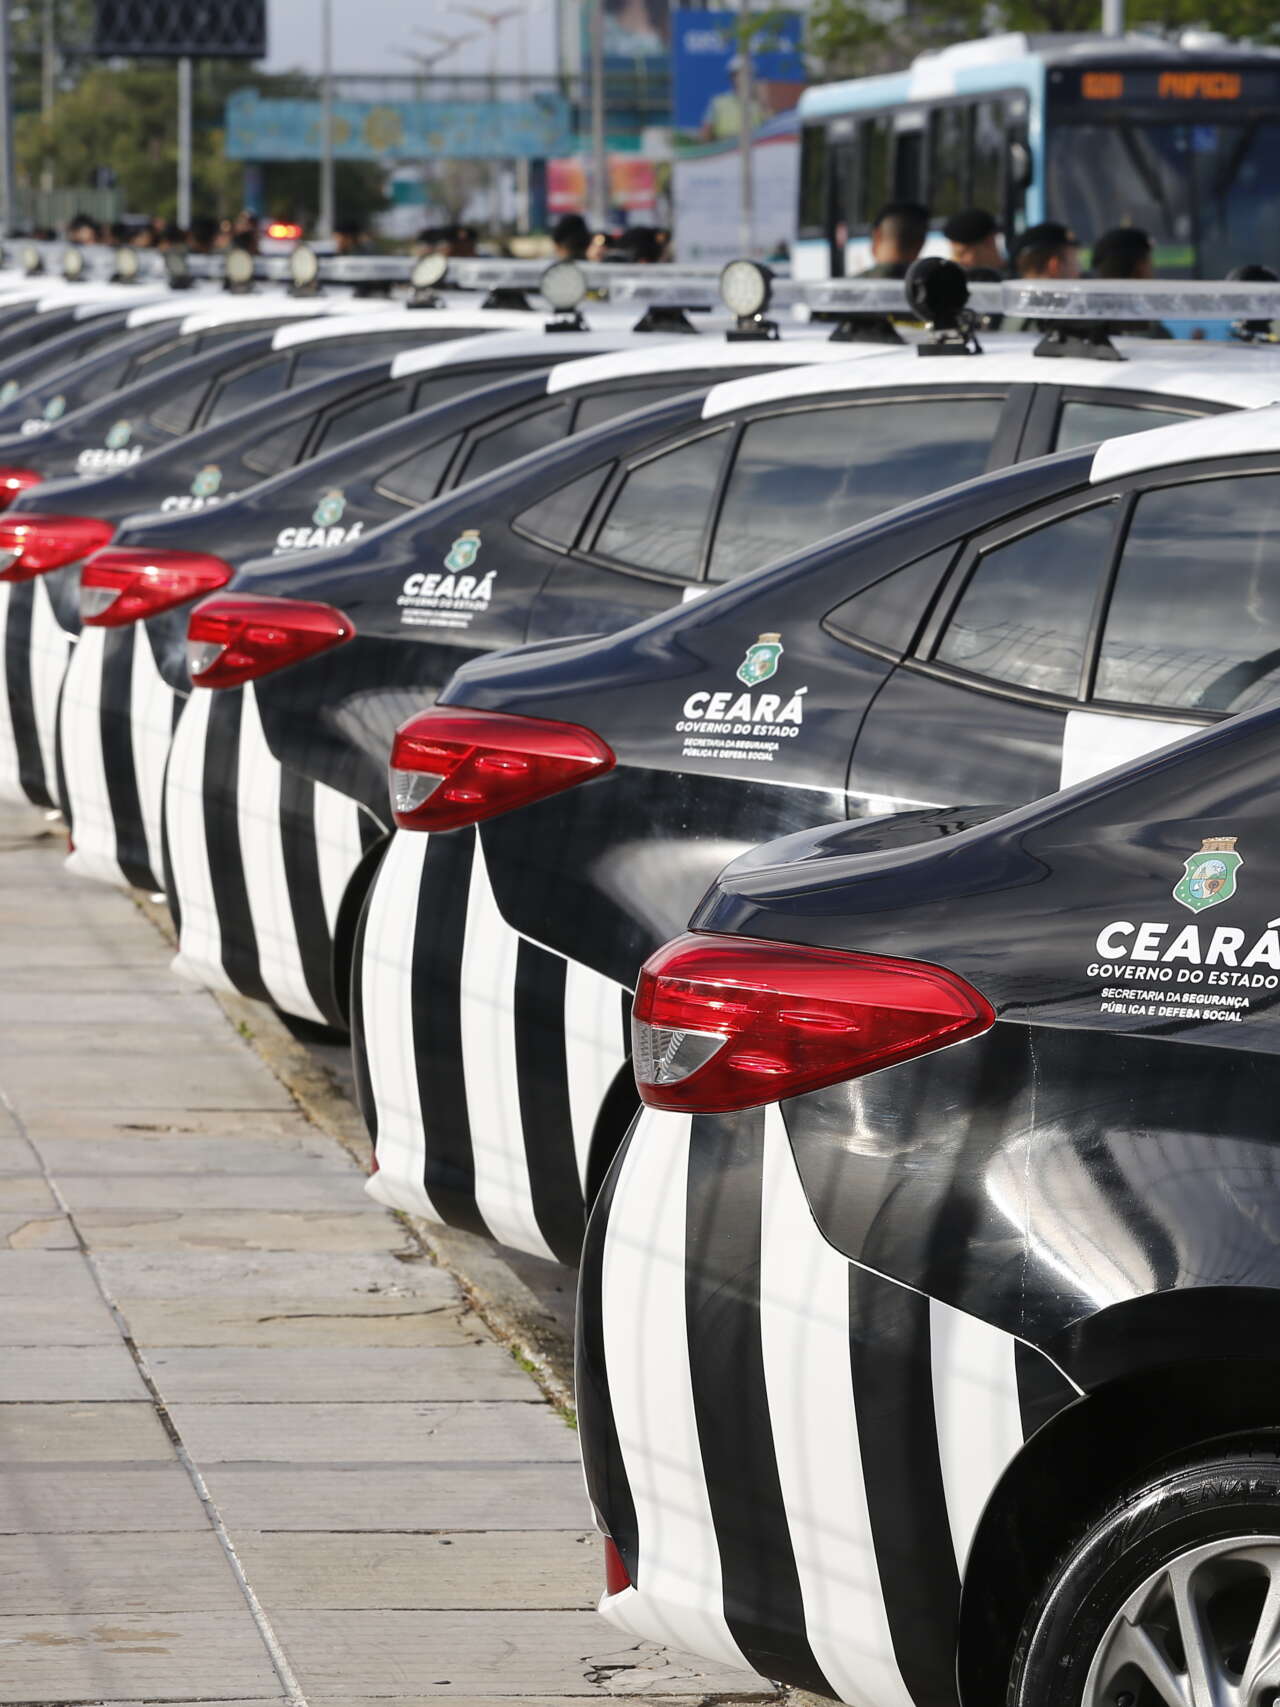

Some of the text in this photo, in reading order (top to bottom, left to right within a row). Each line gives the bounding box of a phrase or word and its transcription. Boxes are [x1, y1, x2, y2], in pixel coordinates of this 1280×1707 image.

[277, 521, 364, 550] CEARÁ
[403, 570, 497, 601] CEARÁ
[683, 686, 808, 724] CEARÁ
[675, 721, 799, 738] GOVERNO DO ESTADO
[1087, 963, 1279, 989] GOVERNO DO ESTADO
[1101, 988, 1250, 1008] SECRETARIA DA SEGURANÇA
[1100, 1001, 1242, 1022] PÚBLICA E DEFESA SOCIAL
